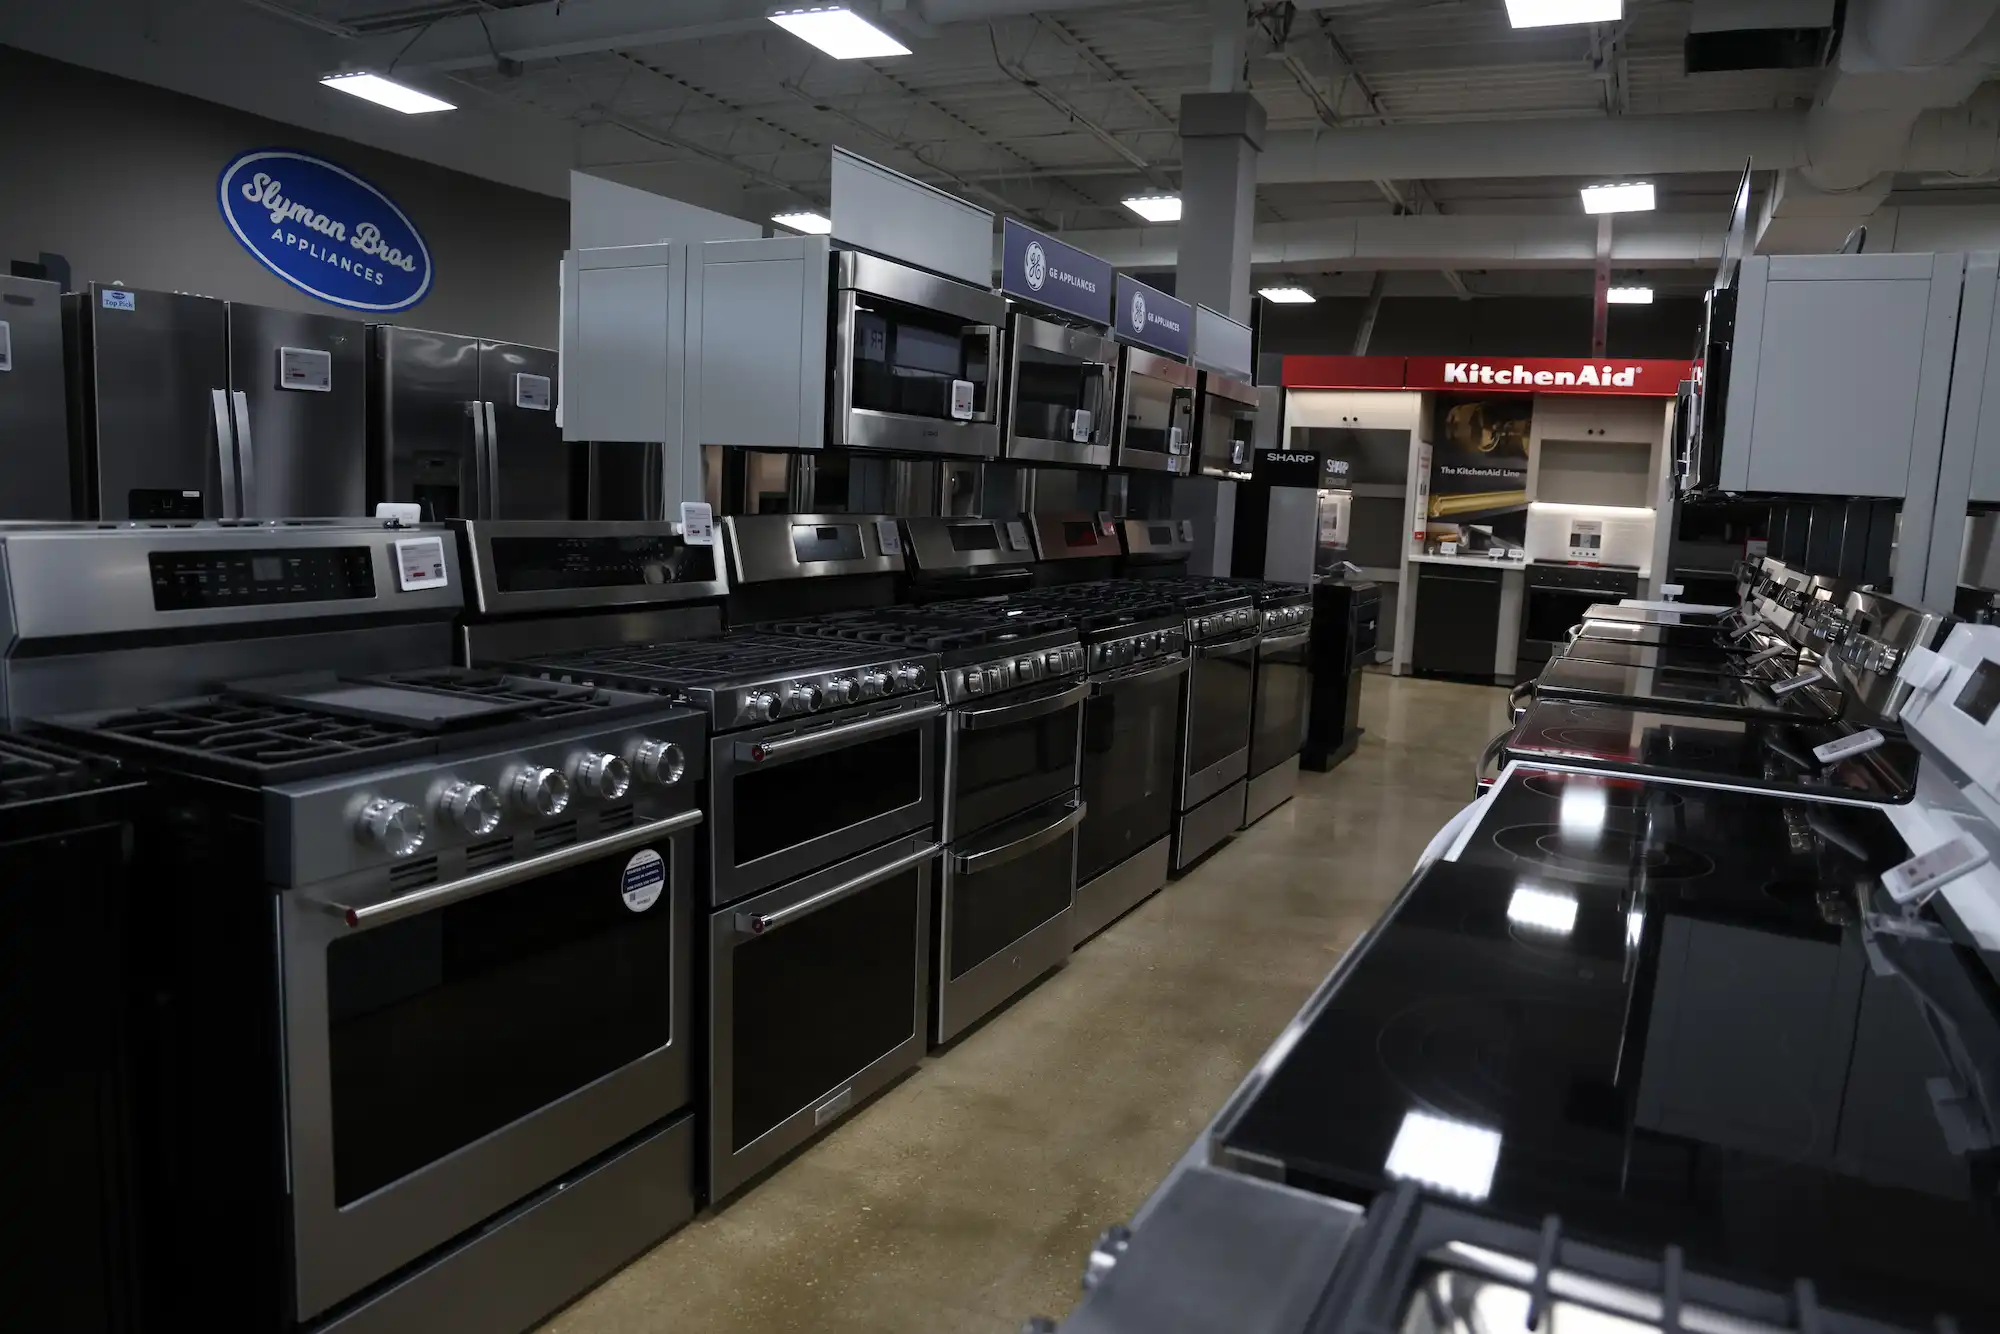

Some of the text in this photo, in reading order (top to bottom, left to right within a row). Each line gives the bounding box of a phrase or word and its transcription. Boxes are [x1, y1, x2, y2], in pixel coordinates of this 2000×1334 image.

[242, 172, 416, 272] Slyman Bros
[271, 228, 384, 286] APPLIANCES
[1049, 267, 1095, 293] GE APPLIANCES
[119, 300, 133, 308] Pick
[1147, 314, 1180, 332] GE APPLIANCES
[1266, 452, 1316, 463] SHARP
[1326, 459, 1349, 474] SHARP
[1440, 466, 1456, 475] The
[1456, 466, 1501, 477] KitchenAid
[1503, 468, 1521, 478] Line
